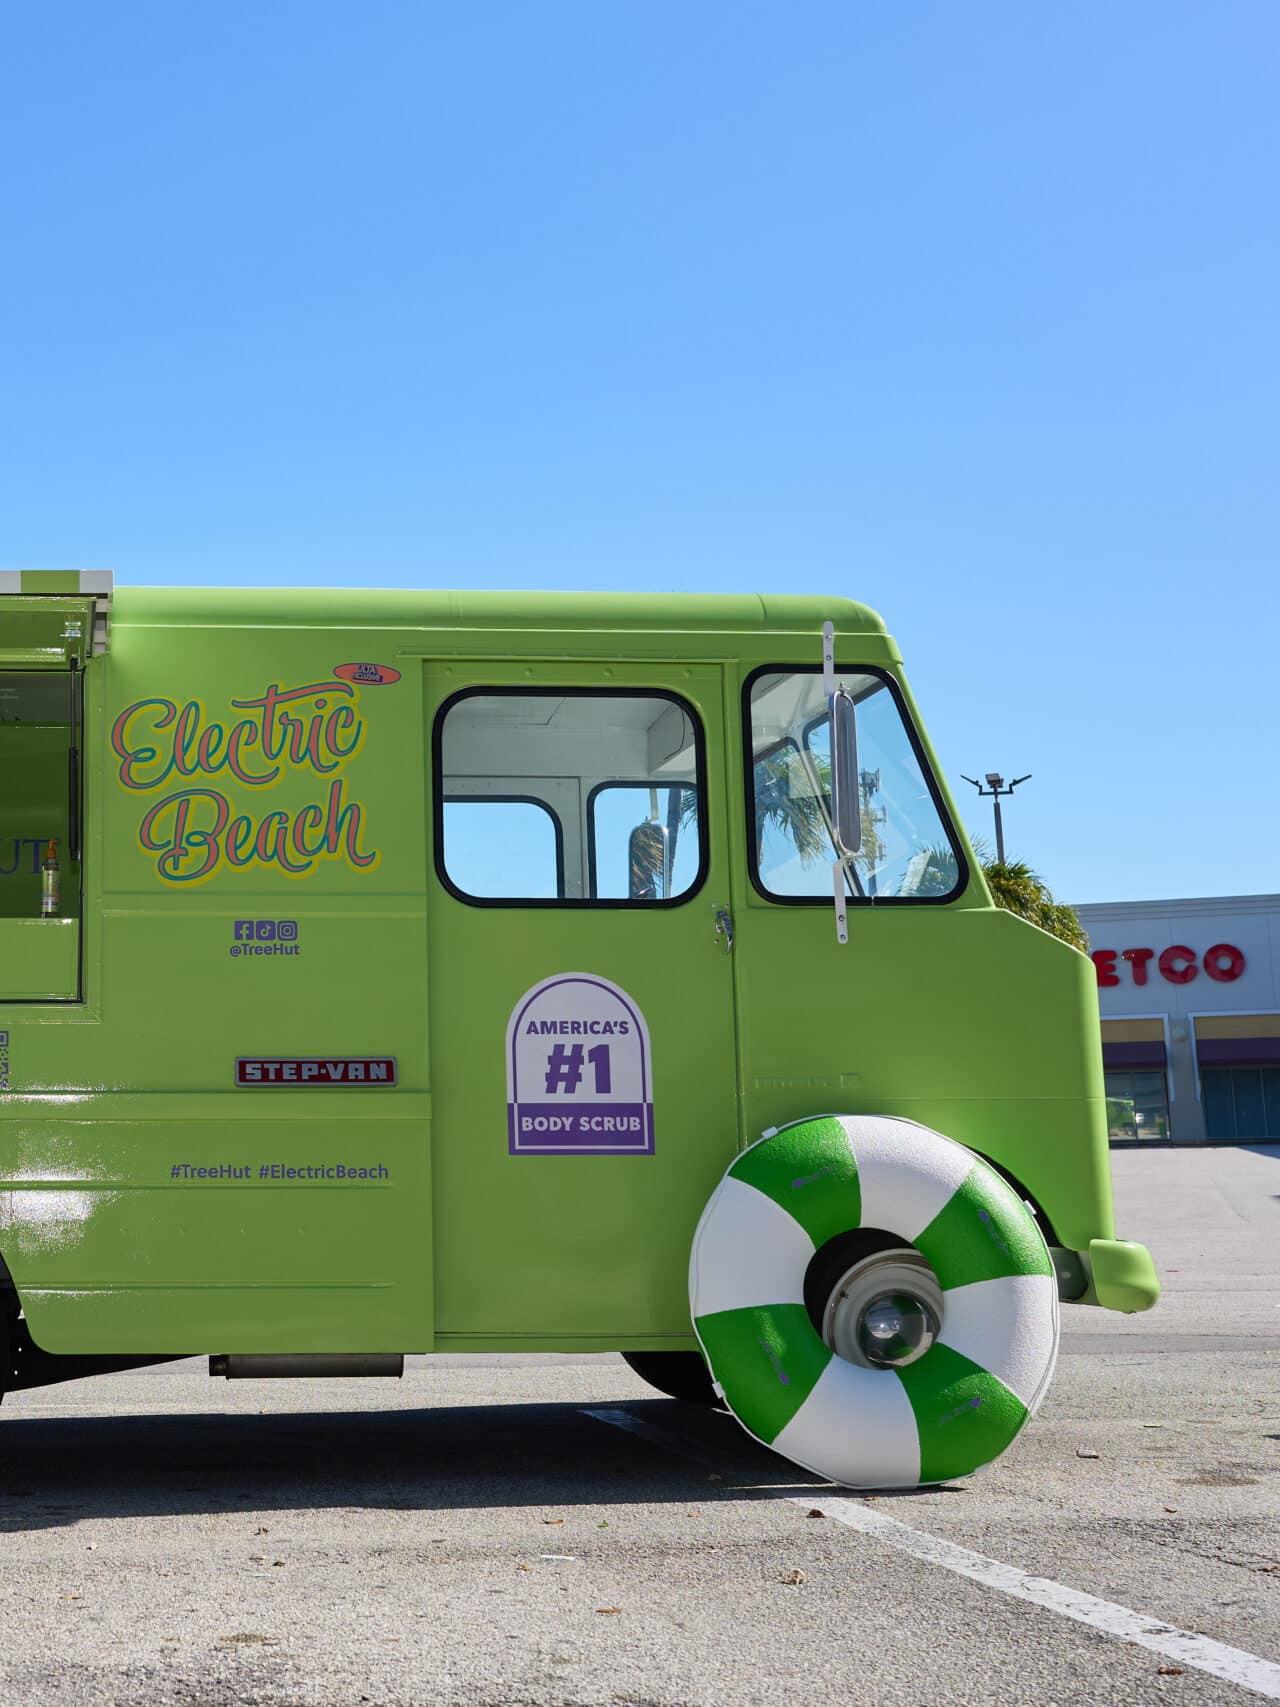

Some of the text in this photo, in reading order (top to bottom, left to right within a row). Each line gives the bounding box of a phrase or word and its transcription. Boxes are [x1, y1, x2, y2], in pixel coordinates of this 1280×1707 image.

[110, 681, 363, 790] Electric
[138, 778, 377, 882] Beach
[229, 943, 300, 957] @TreeHut
[1091, 943, 1246, 987] ETCO
[526, 1020, 630, 1035] AMERICA'S
[545, 1043, 612, 1094] #1
[521, 1116, 641, 1132] BODY SCRUB
[170, 1163, 389, 1180] #TreeHut #ElectricBeach
